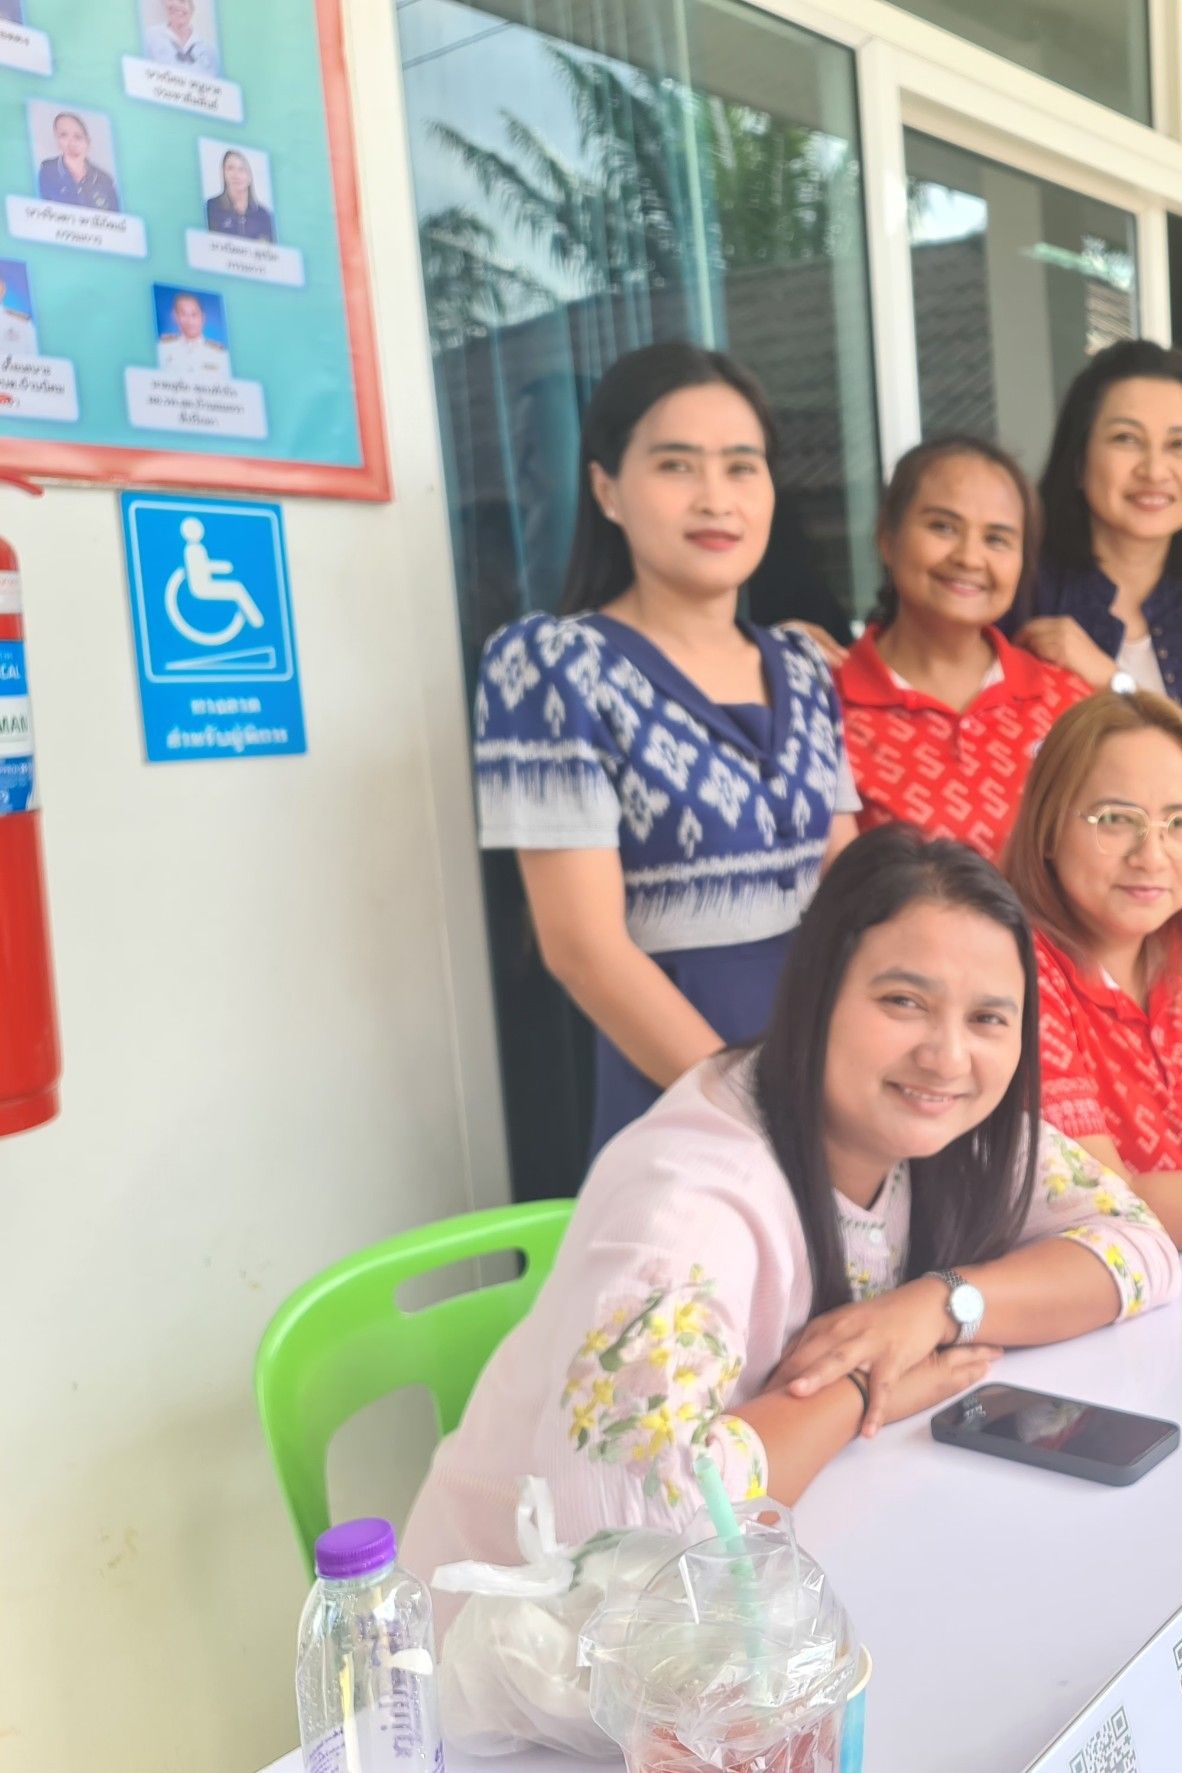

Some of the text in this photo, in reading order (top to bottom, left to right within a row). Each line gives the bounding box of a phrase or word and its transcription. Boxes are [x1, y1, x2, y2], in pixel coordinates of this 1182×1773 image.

[191, 696, 262, 716] ทางลาด
[166, 723, 289, 754] สำหรับผู้พิการ
